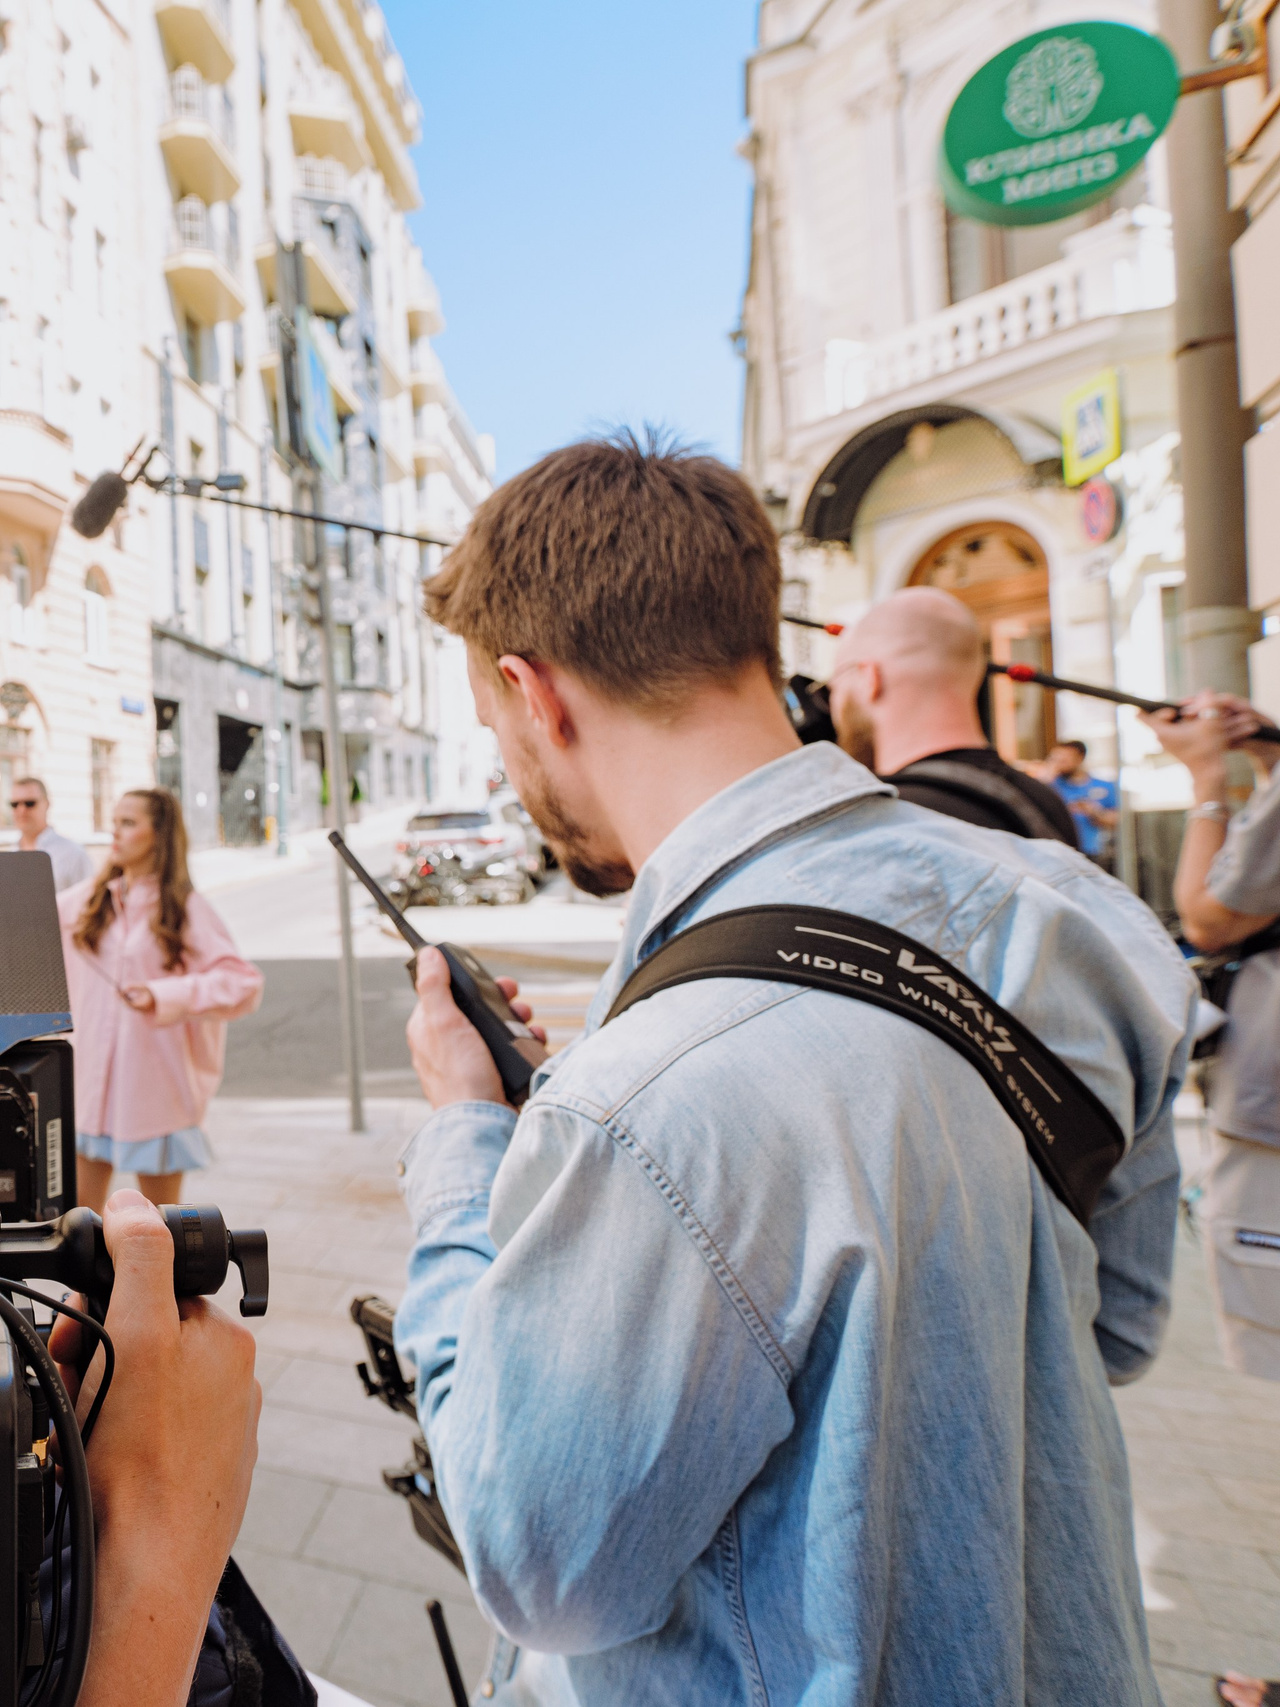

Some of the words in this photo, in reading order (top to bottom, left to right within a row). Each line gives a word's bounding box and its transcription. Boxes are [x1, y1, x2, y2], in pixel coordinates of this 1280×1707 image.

[776, 949, 884, 985] VIDEO
[898, 982, 1003, 1073] WIRELESS
[1006, 1074, 1055, 1146] SYSTEM
[19, 1325, 40, 1354] MADE
[41, 1358, 50, 1370] IN
[49, 1375, 69, 1413] JAPAN
